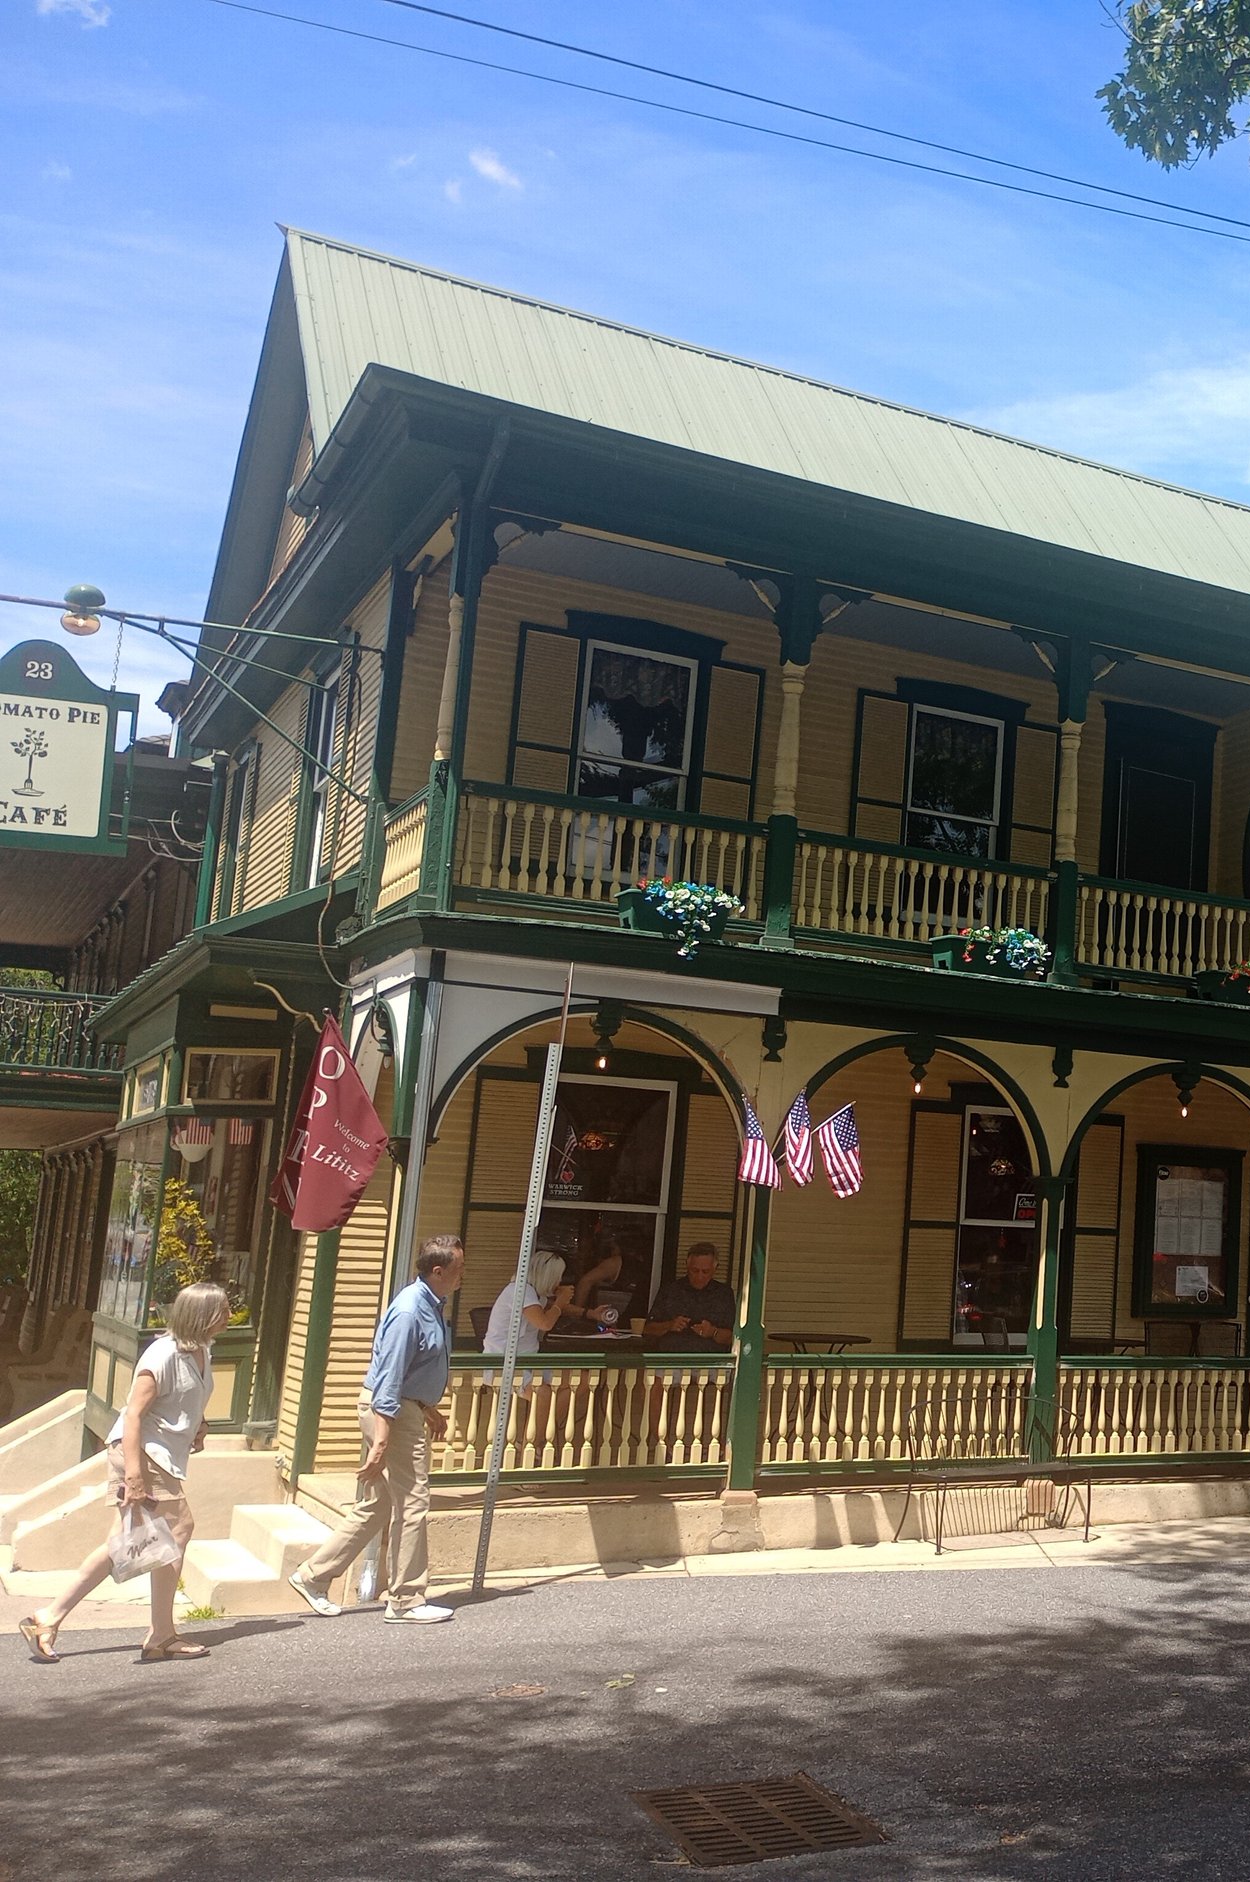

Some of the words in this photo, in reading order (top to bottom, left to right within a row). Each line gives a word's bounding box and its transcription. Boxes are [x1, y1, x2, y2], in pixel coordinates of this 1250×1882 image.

[25, 661, 53, 680] 23
[0, 703, 61, 721] MATO
[67, 706, 101, 725] PIE
[333, 1119, 370, 1150] Welcome
[342, 1143, 351, 1153] to
[310, 1144, 361, 1182] Lititz
[548, 1183, 584, 1191] WARWICK
